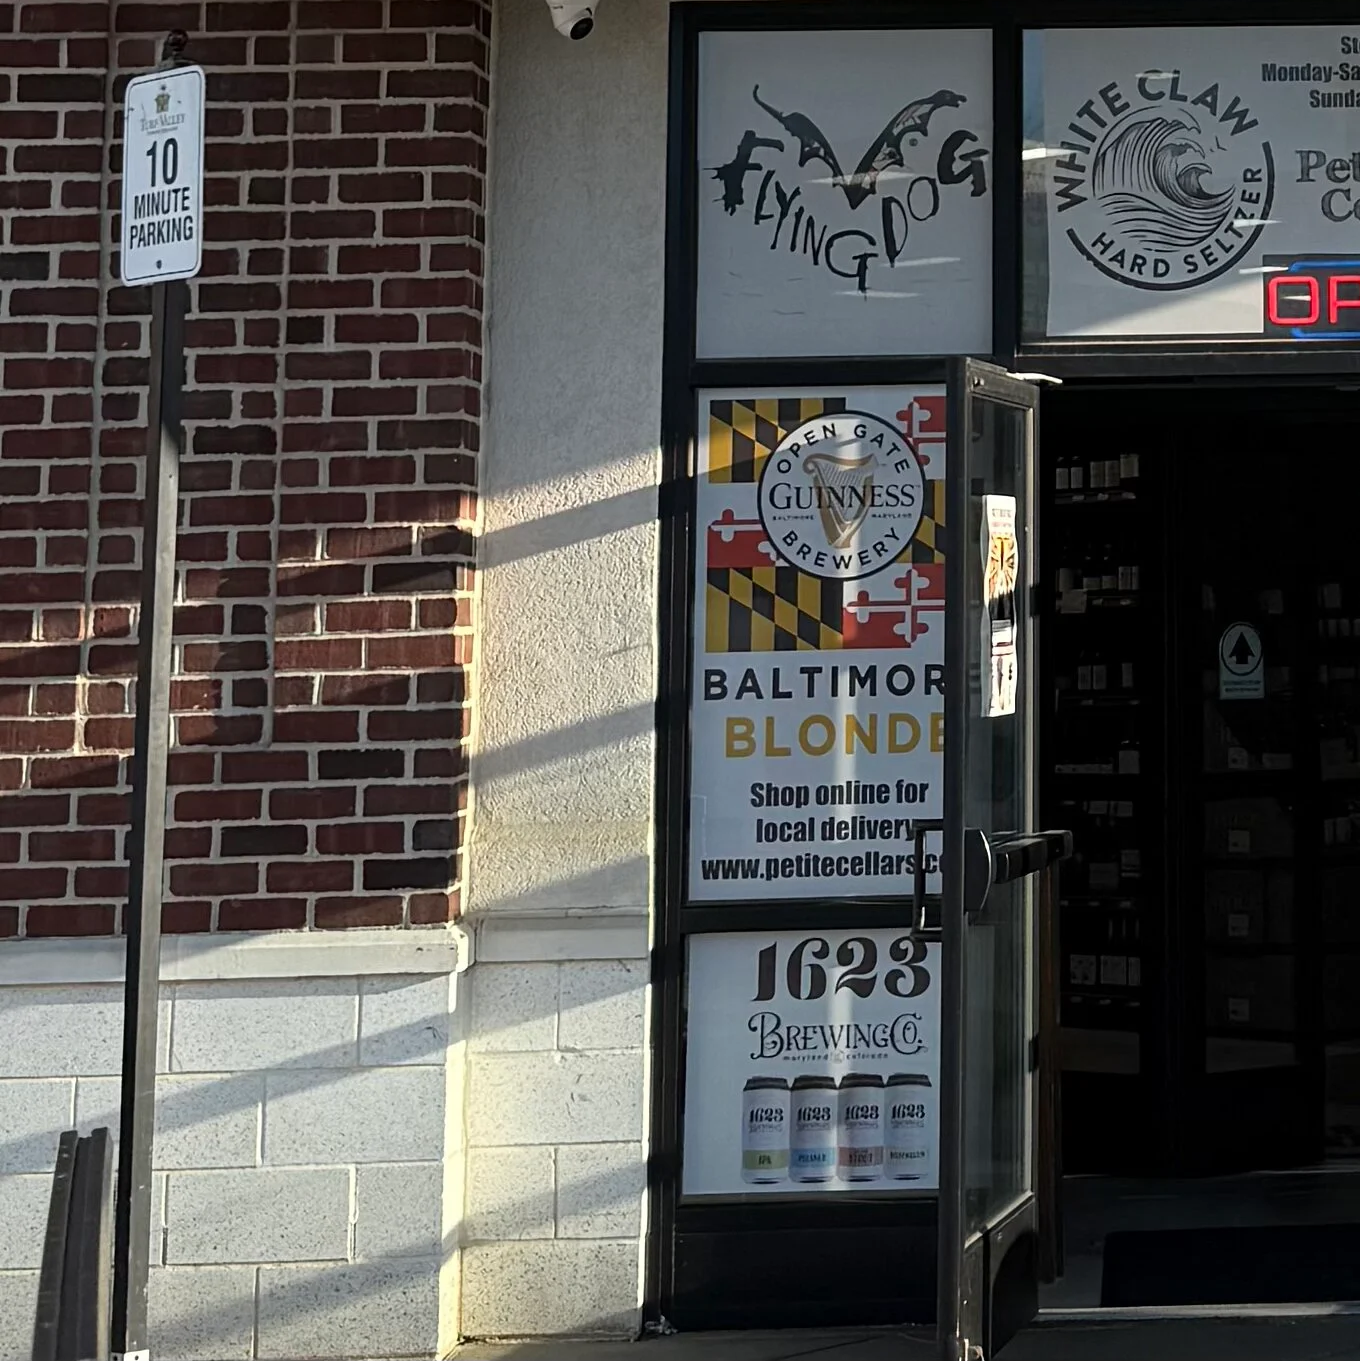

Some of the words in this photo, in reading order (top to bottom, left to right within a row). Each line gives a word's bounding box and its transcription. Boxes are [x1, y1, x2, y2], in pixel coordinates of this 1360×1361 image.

[1053, 81, 1132, 213] WHITE
[1137, 69, 1259, 137] CLAW
[146, 137, 179, 188] 10
[133, 186, 191, 221] MINUTE
[703, 128, 880, 301] FLYING
[881, 128, 991, 269] DOG
[129, 214, 194, 250] PARKING
[1090, 231, 1171, 279] HARD
[1183, 167, 1263, 274] SELTZER
[776, 422, 837, 475] OPEN
[853, 423, 911, 475] GATE
[768, 482, 916, 510] GUINNESS
[781, 526, 901, 570] BREWERY
[703, 662, 945, 701] BALTIMOR
[749, 782, 810, 809] Shop
[815, 780, 890, 806] online
[895, 778, 930, 803] for
[755, 818, 815, 843] local
[820, 815, 915, 842] delivery
[750, 935, 931, 1002] 1623
[747, 1011, 889, 1060] BREWING
[749, 1107, 784, 1123] 1623
[796, 1106, 831, 1122] 1623
[844, 1104, 879, 1121] 1623
[891, 1103, 926, 1120] 1623
